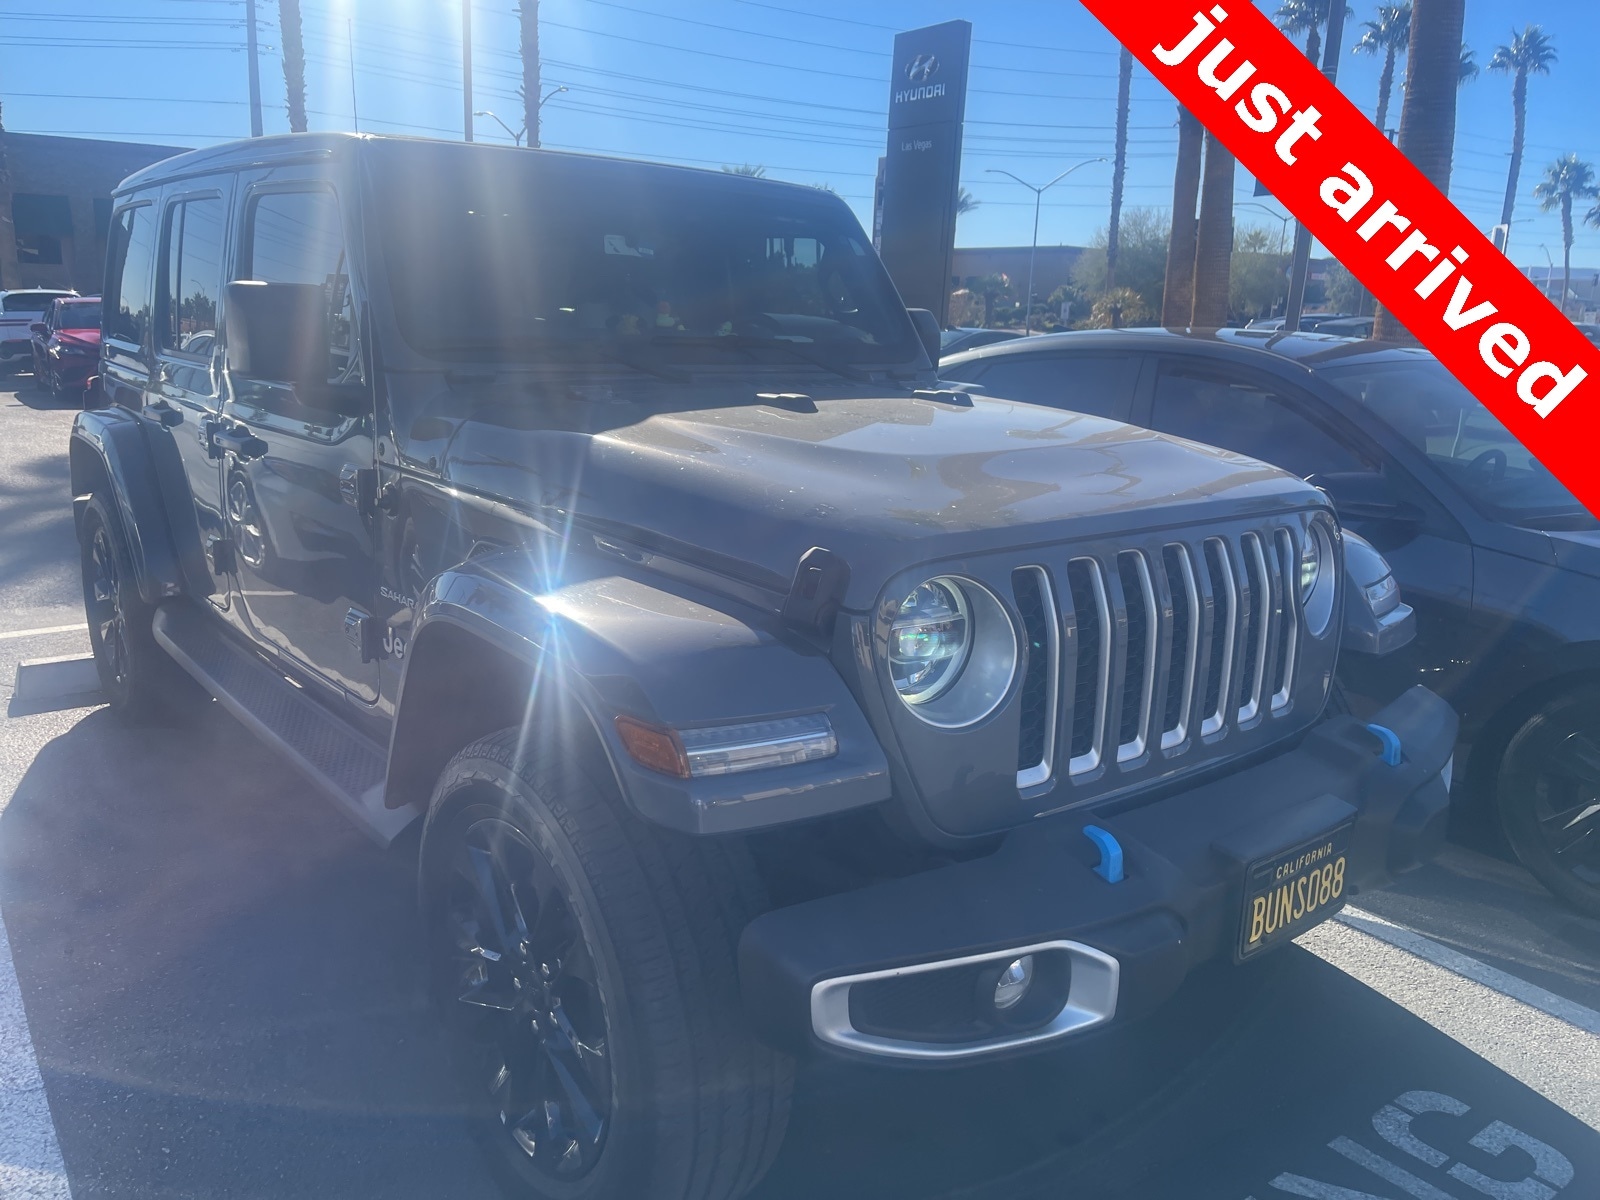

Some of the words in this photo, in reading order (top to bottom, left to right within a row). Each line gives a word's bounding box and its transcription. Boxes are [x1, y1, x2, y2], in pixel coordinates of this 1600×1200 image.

[895, 83, 945, 104] HYUNDAI
[901, 141, 912, 151] Las
[913, 139, 932, 152] Vegas
[382, 626, 408, 659] Je
[1276, 842, 1332, 879] CALIFORNIA
